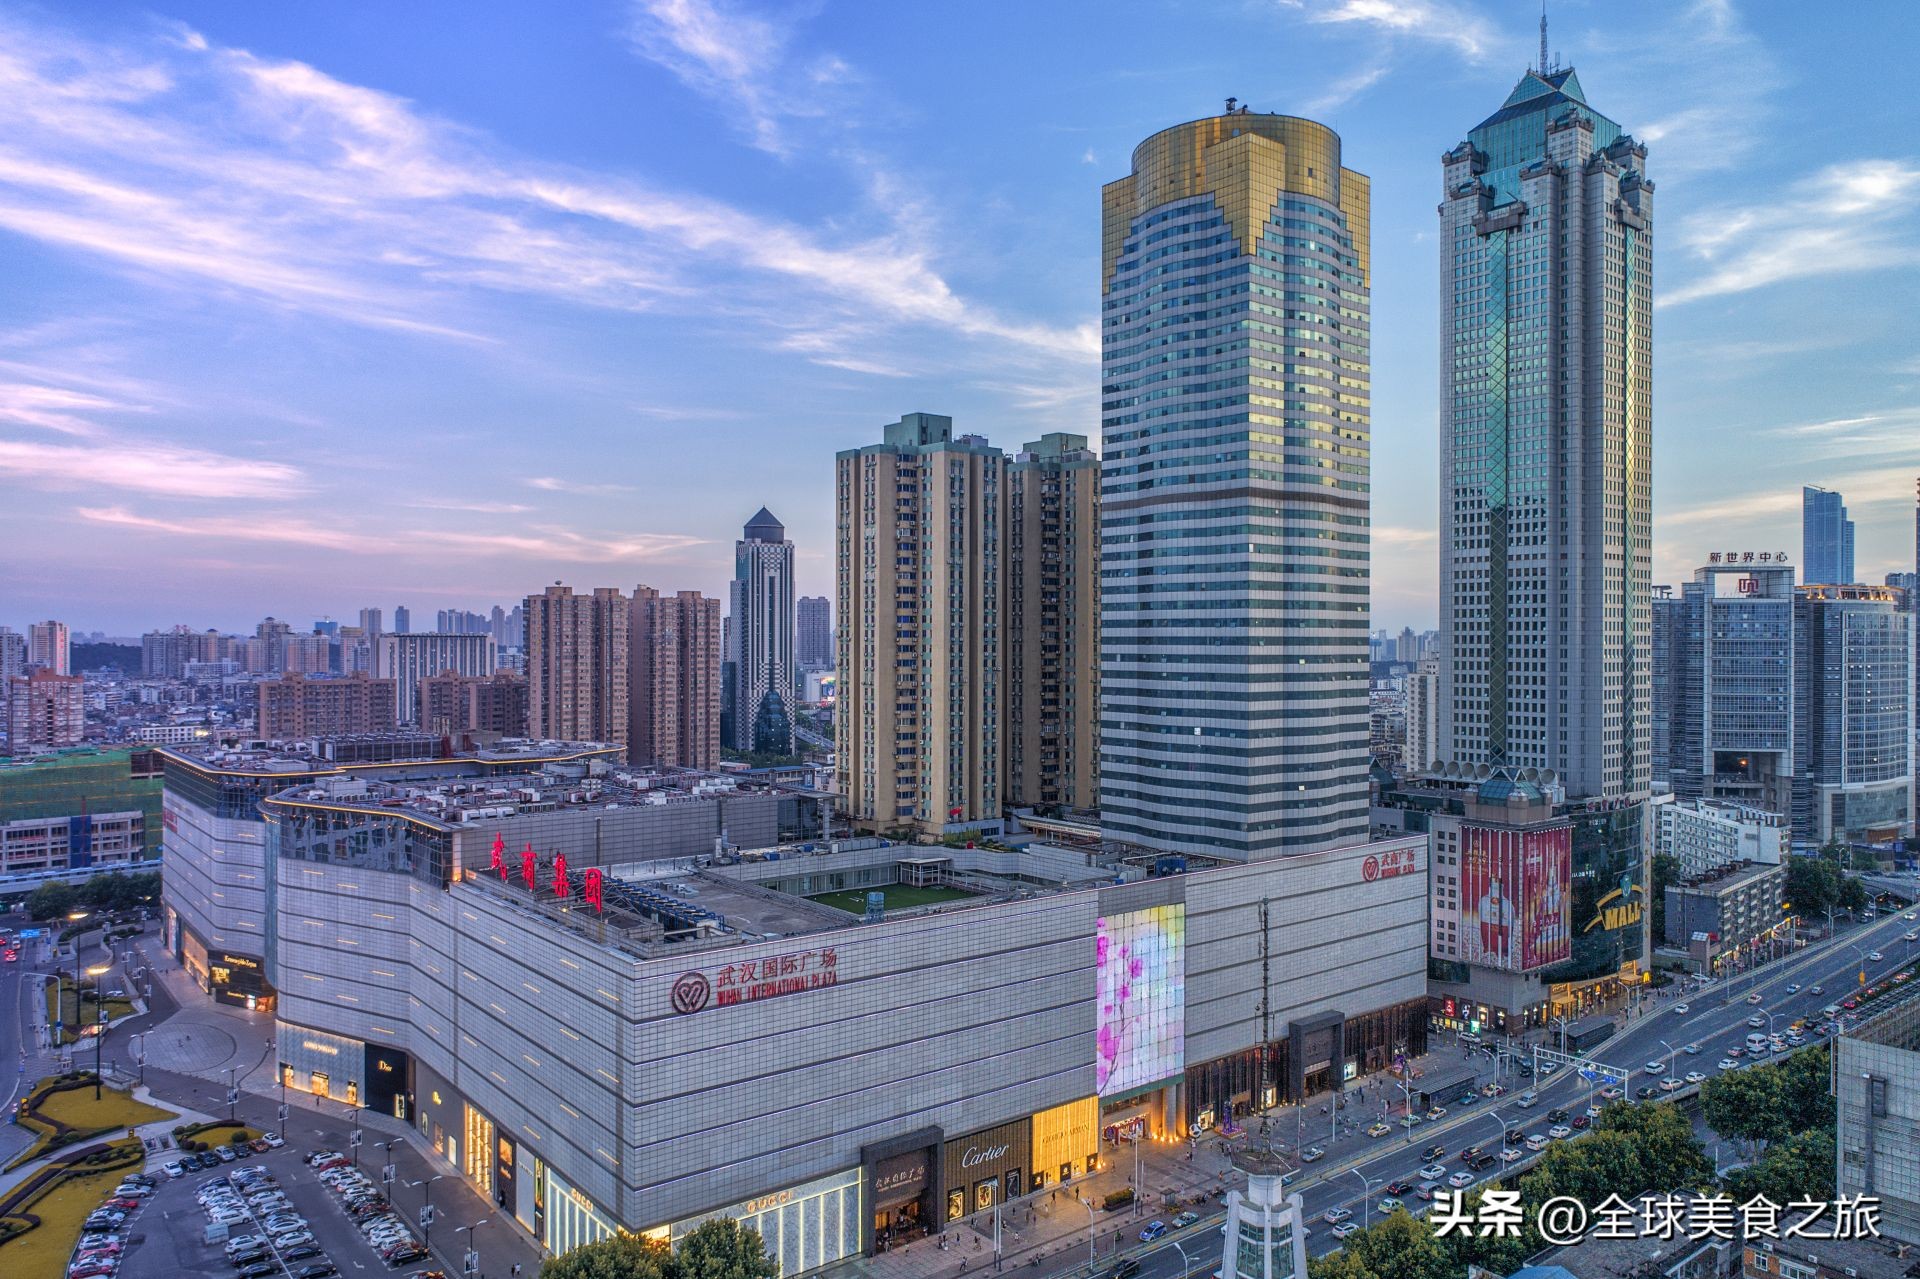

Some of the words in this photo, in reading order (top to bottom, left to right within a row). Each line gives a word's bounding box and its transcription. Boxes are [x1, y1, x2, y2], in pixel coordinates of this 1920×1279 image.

[1709, 551, 1788, 563] 新世界中心
[1605, 901, 1641, 930] MALL
[717, 948, 837, 988] 武汉国际广场
[717, 988, 742, 1007] WUHAN
[747, 975, 809, 1001] INTERNATIONAL
[812, 970, 837, 988] PLAZA
[380, 1060, 393, 1072] Dior
[962, 1144, 1009, 1168] Cartier
[571, 1187, 594, 1213] GUCCI
[748, 1191, 793, 1213] GUCCI
